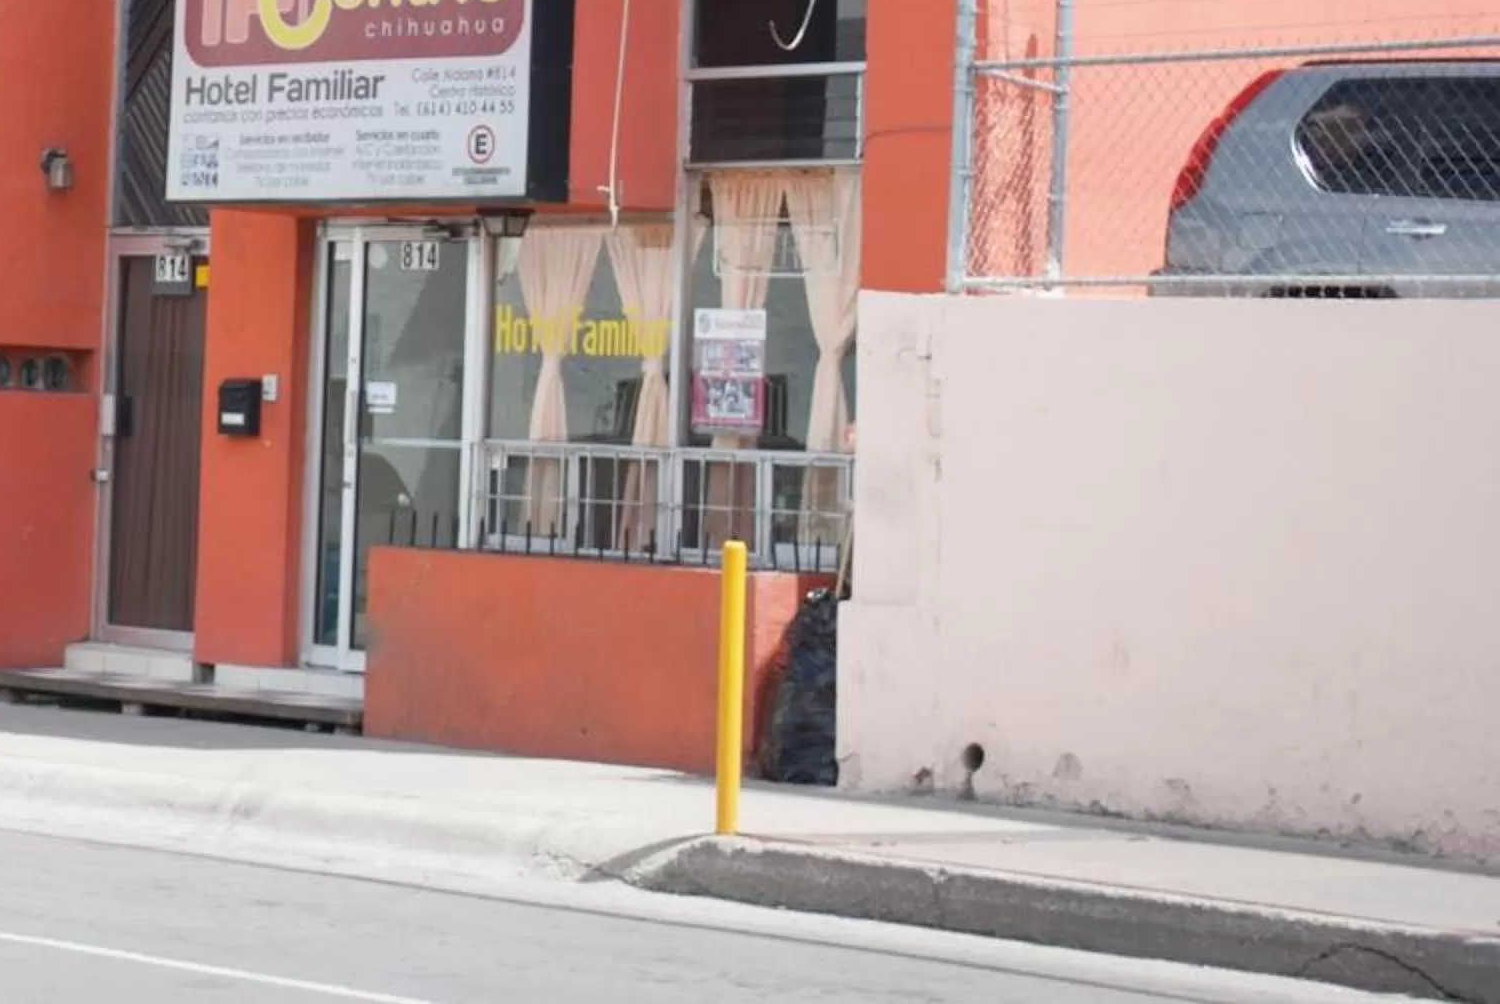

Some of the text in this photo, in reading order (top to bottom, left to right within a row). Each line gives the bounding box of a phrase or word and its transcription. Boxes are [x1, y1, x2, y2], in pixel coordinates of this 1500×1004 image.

[364, 16, 505, 38] chihuahua
[184, 68, 386, 106] Hotel Familiar
[474, 133, 487, 155] E
[157, 255, 187, 280] 814
[402, 242, 437, 269] 814
